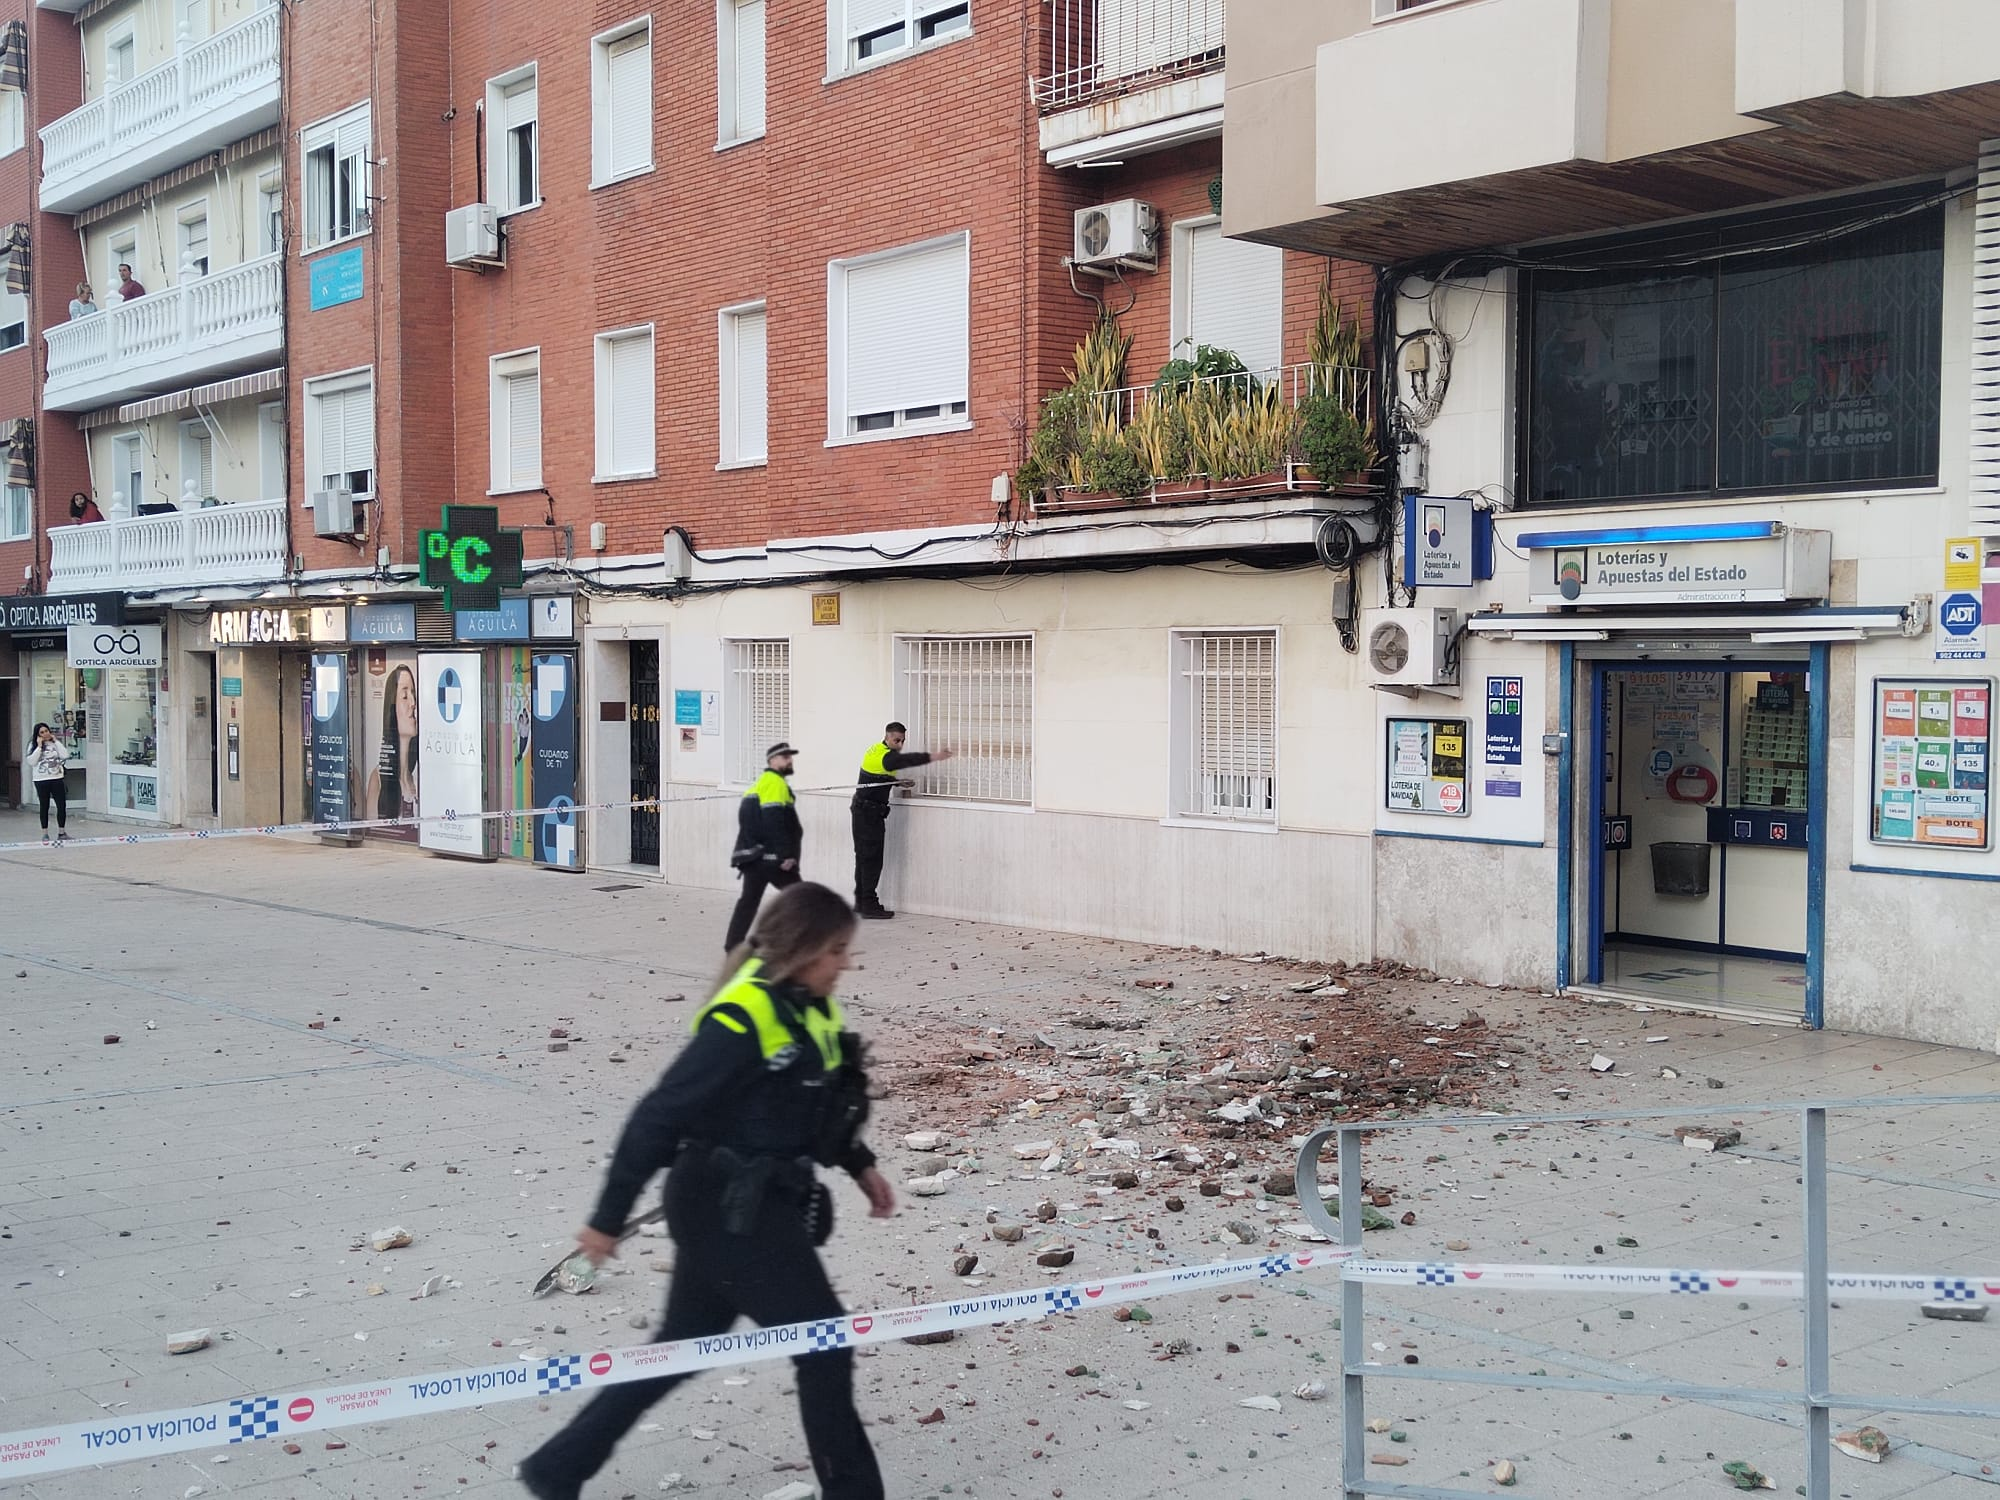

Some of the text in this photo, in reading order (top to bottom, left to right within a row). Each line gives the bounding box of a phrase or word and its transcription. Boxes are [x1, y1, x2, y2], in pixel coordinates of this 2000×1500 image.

[1812, 409, 1889, 433] El Niño
[1806, 431, 1893, 448] 6 de enero
[1597, 549, 1668, 567] Loterías y
[1423, 561, 1461, 570] Apuestas del
[1423, 570, 1444, 578] Estado
[1597, 565, 1747, 586] Apuestas del Estado
[10, 600, 97, 626] OPTICA ARGÜELLES
[1946, 606, 1977, 623] ADT
[622, 626, 629, 639] 2
[75, 657, 157, 666] OPTICA ARGÜELLES
[1441, 743, 1457, 751] 135
[1511, 745, 1521, 753] del
[539, 750, 569, 760] CUIDAMOS
[546, 759, 563, 768] DE TI
[137, 781, 156, 798] KARL
[1414, 782, 1421, 790] DE
[1443, 787, 1457, 796] +18
[1391, 791, 1414, 800] NAVIDAD
[1945, 795, 1972, 803] BOTE
[1946, 820, 1973, 828] BOTE
[694, 1326, 798, 1355] POLICÍA LOCAL
[635, 1354, 668, 1366] NO PASAR
[409, 1366, 527, 1400] POLICÍA LOCAL
[326, 1387, 392, 1405] LÍNEA DE POLICÍA
[340, 1399, 378, 1411] NO PASAR
[80, 1413, 217, 1450] POLICÍA LOCAL
[22, 1441, 33, 1450] DE
[36, 1436, 61, 1447] LÍNEA
[1, 1449, 46, 1463] NO PASAR
